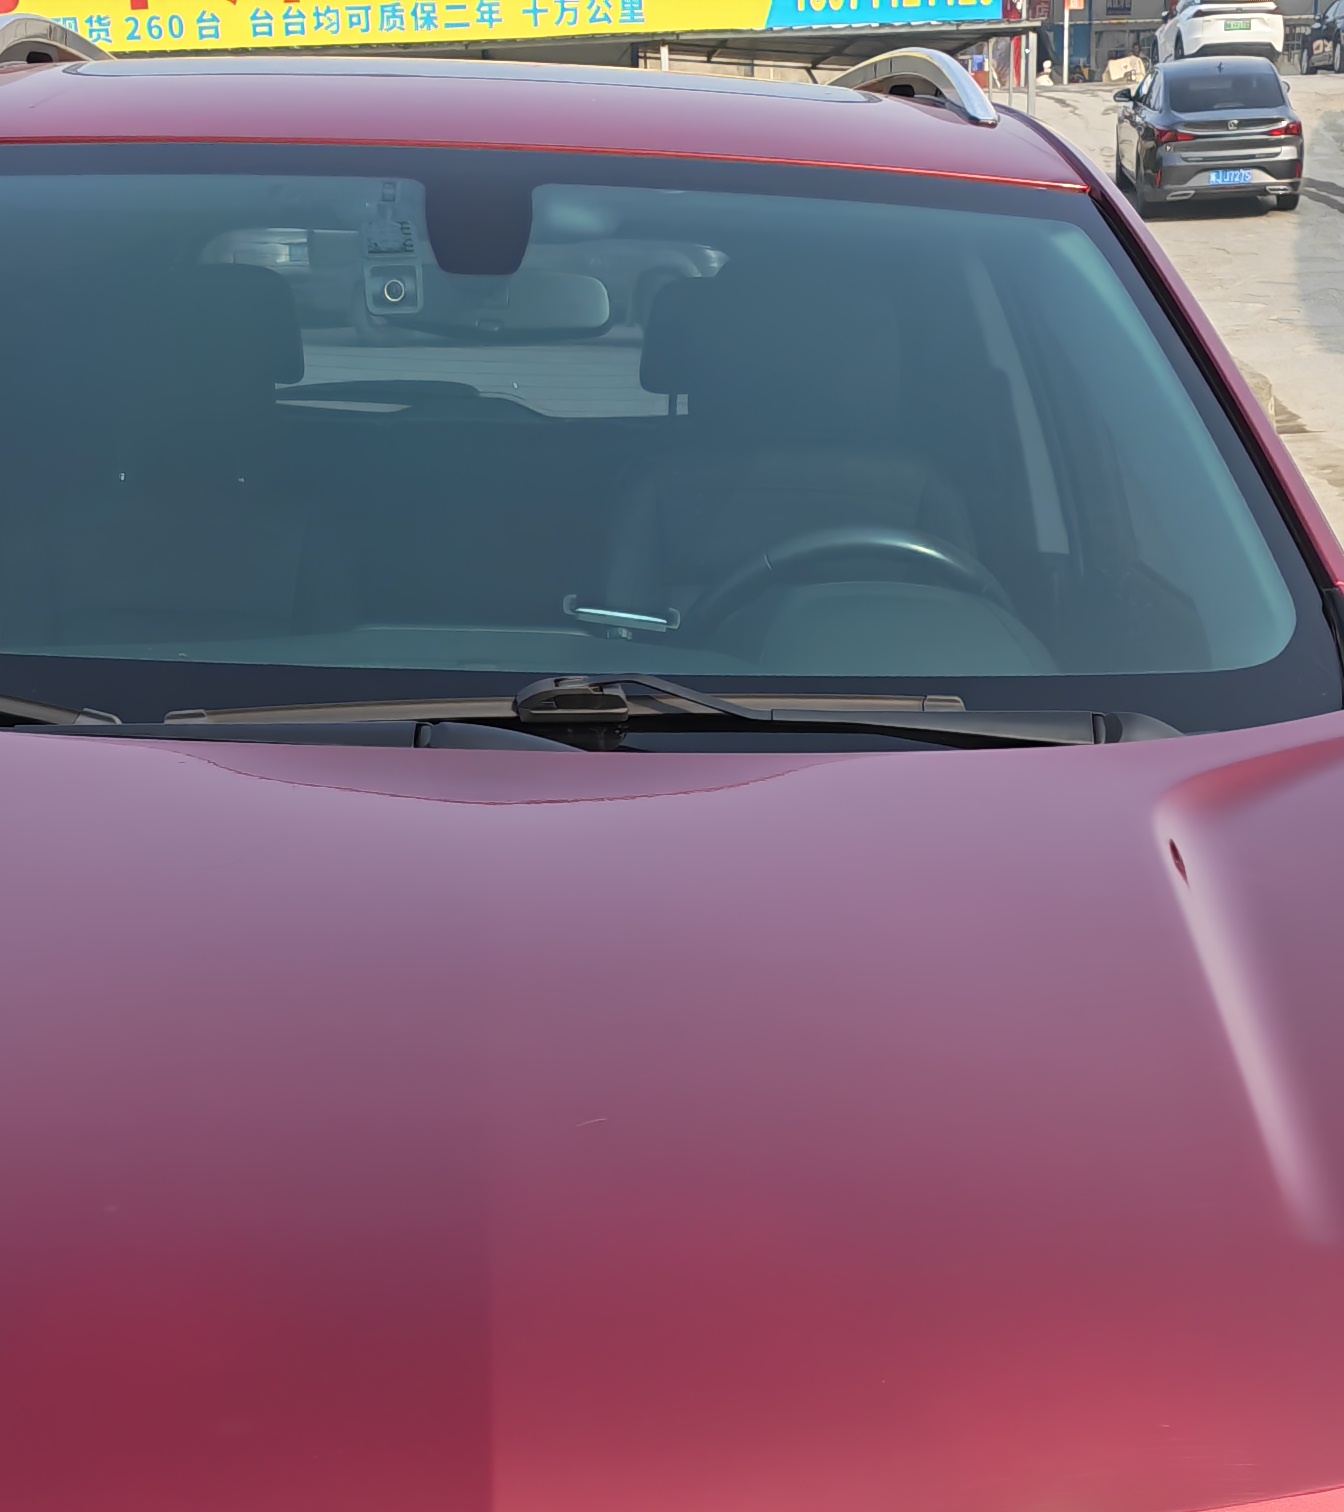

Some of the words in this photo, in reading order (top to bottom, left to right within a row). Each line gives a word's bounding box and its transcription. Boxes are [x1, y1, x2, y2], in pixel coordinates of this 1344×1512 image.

[124, 14, 185, 41] 260
[195, 10, 221, 41] 台
[249, 0, 504, 39] 台台均可质保二年
[522, 0, 646, 28] 十万公里
